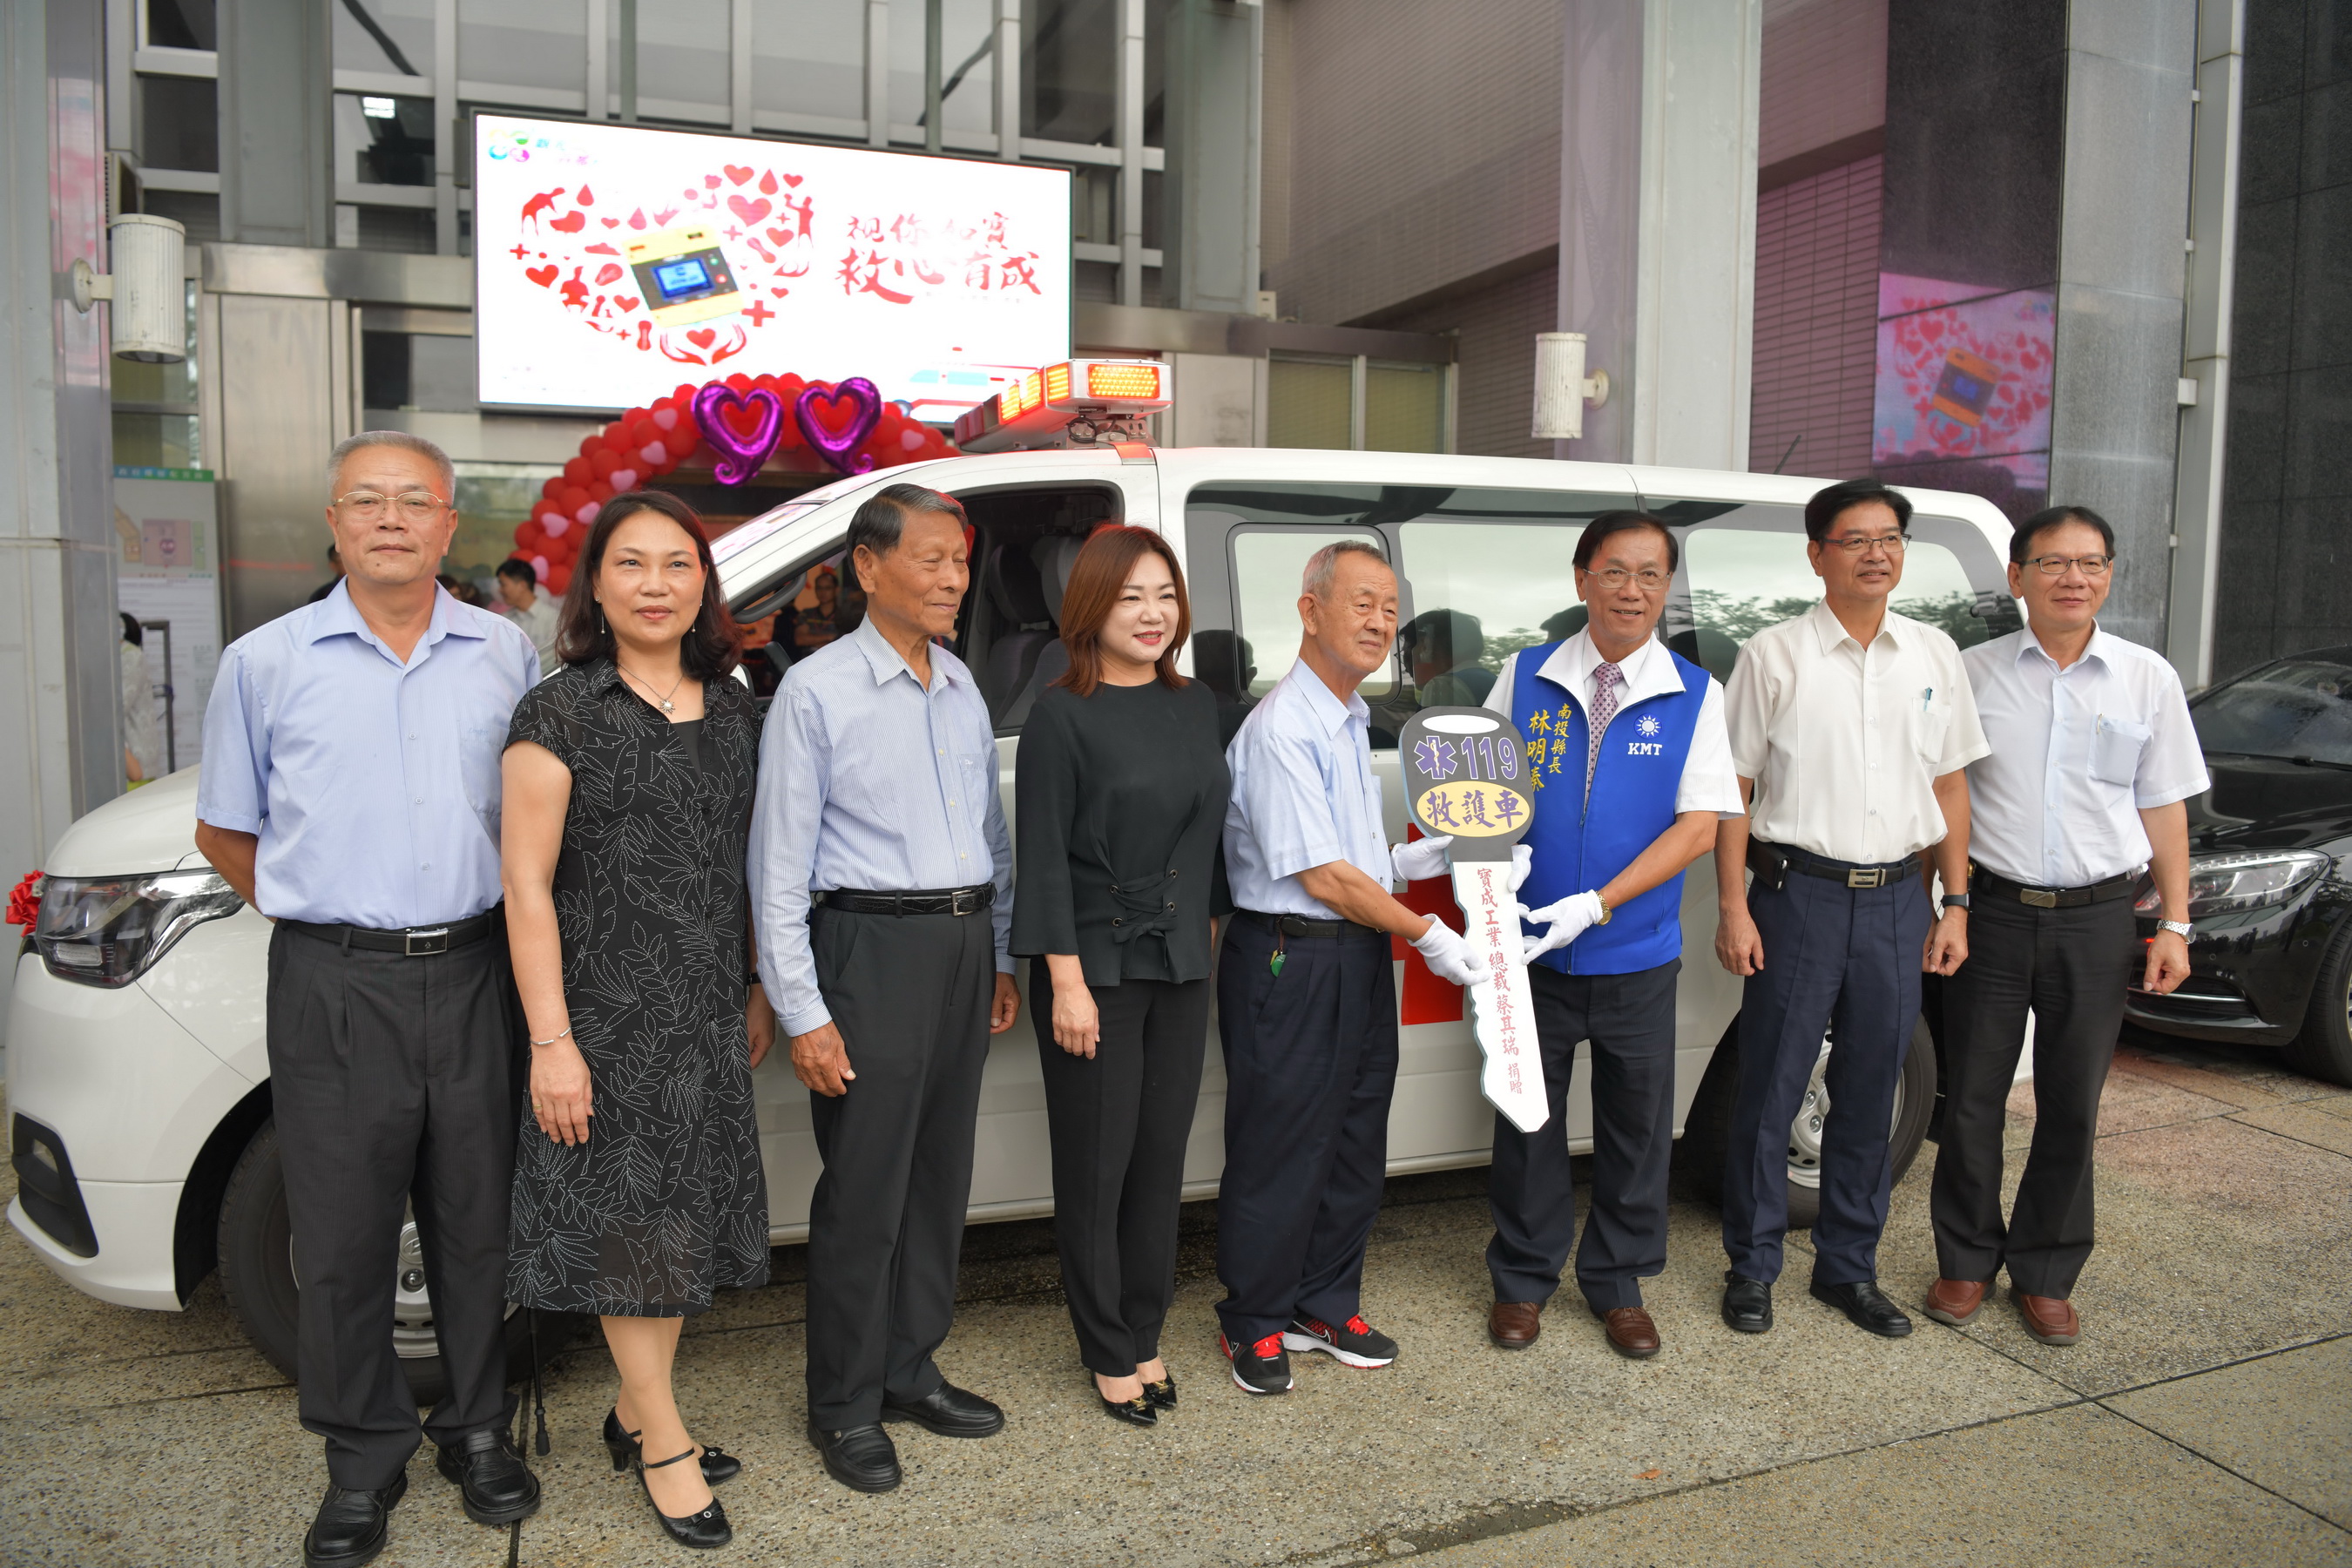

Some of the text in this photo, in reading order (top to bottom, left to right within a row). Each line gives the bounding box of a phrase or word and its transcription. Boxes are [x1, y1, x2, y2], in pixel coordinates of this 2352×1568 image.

[1461, 736, 1517, 780] 119
[1548, 703, 1572, 774] 南投縣長
[1627, 742, 1663, 756] KMT
[1426, 789, 1524, 828] 救護車
